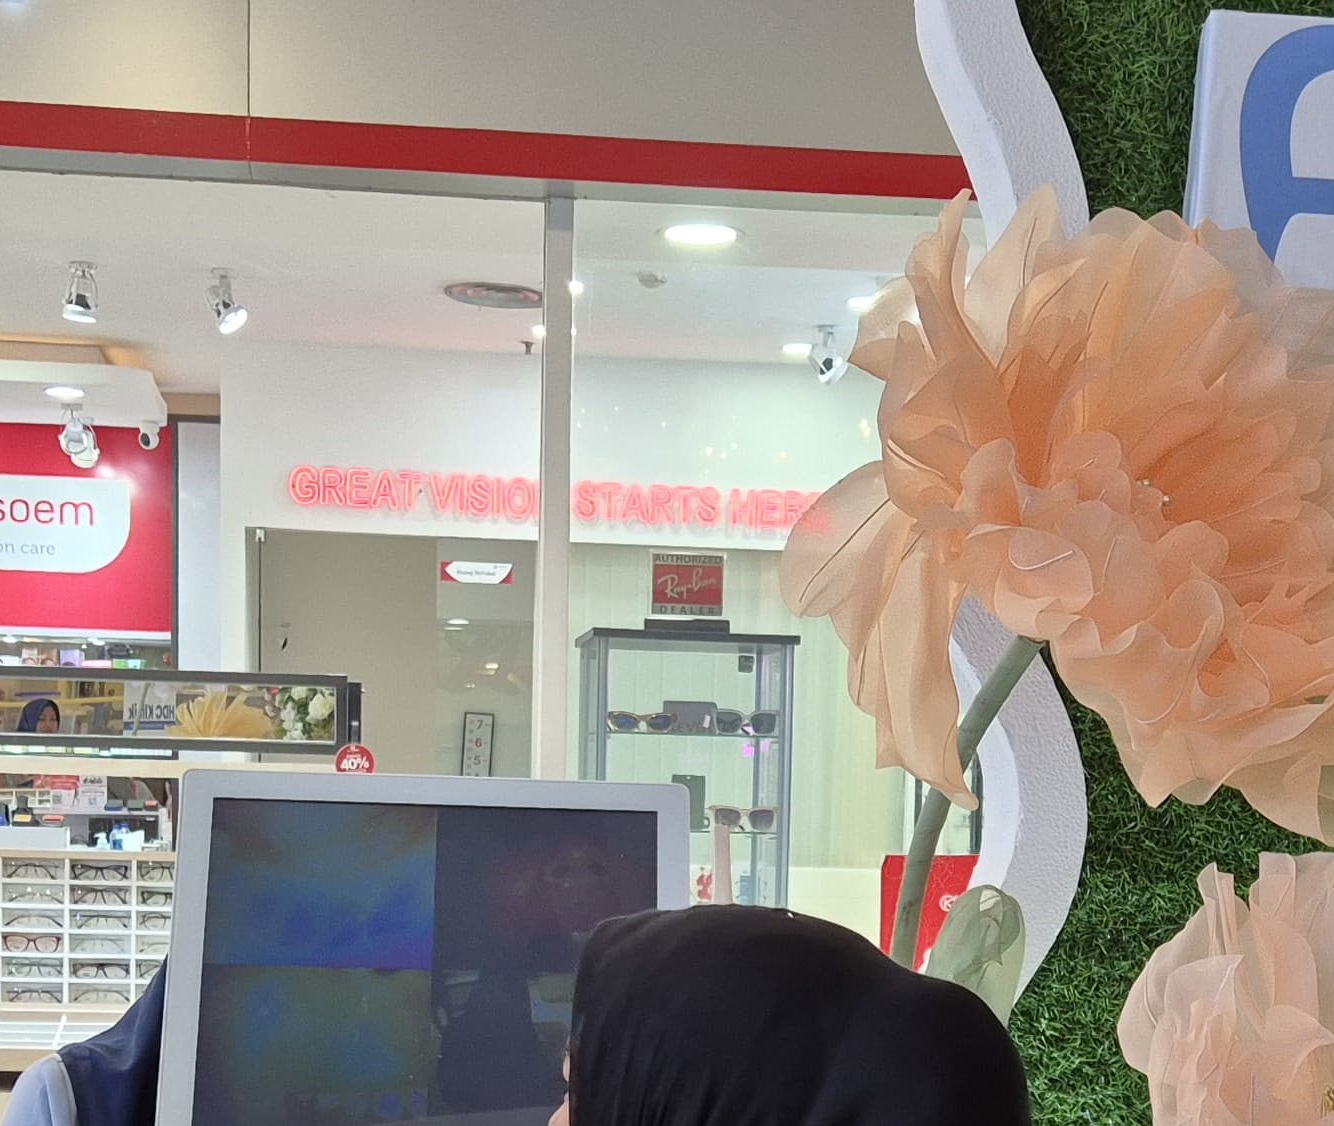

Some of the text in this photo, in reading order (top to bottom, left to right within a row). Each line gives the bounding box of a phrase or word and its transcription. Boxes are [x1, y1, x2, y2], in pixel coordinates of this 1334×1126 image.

[287, 464, 422, 511] GREAT
[574, 479, 722, 527] STARTS
[21, 545, 56, 556] care
[655, 553, 722, 565] AUTHORIZED
[657, 567, 716, 601] Ray-Ban
[660, 605, 715, 616] DEALER
[340, 756, 370, 770] 40%
